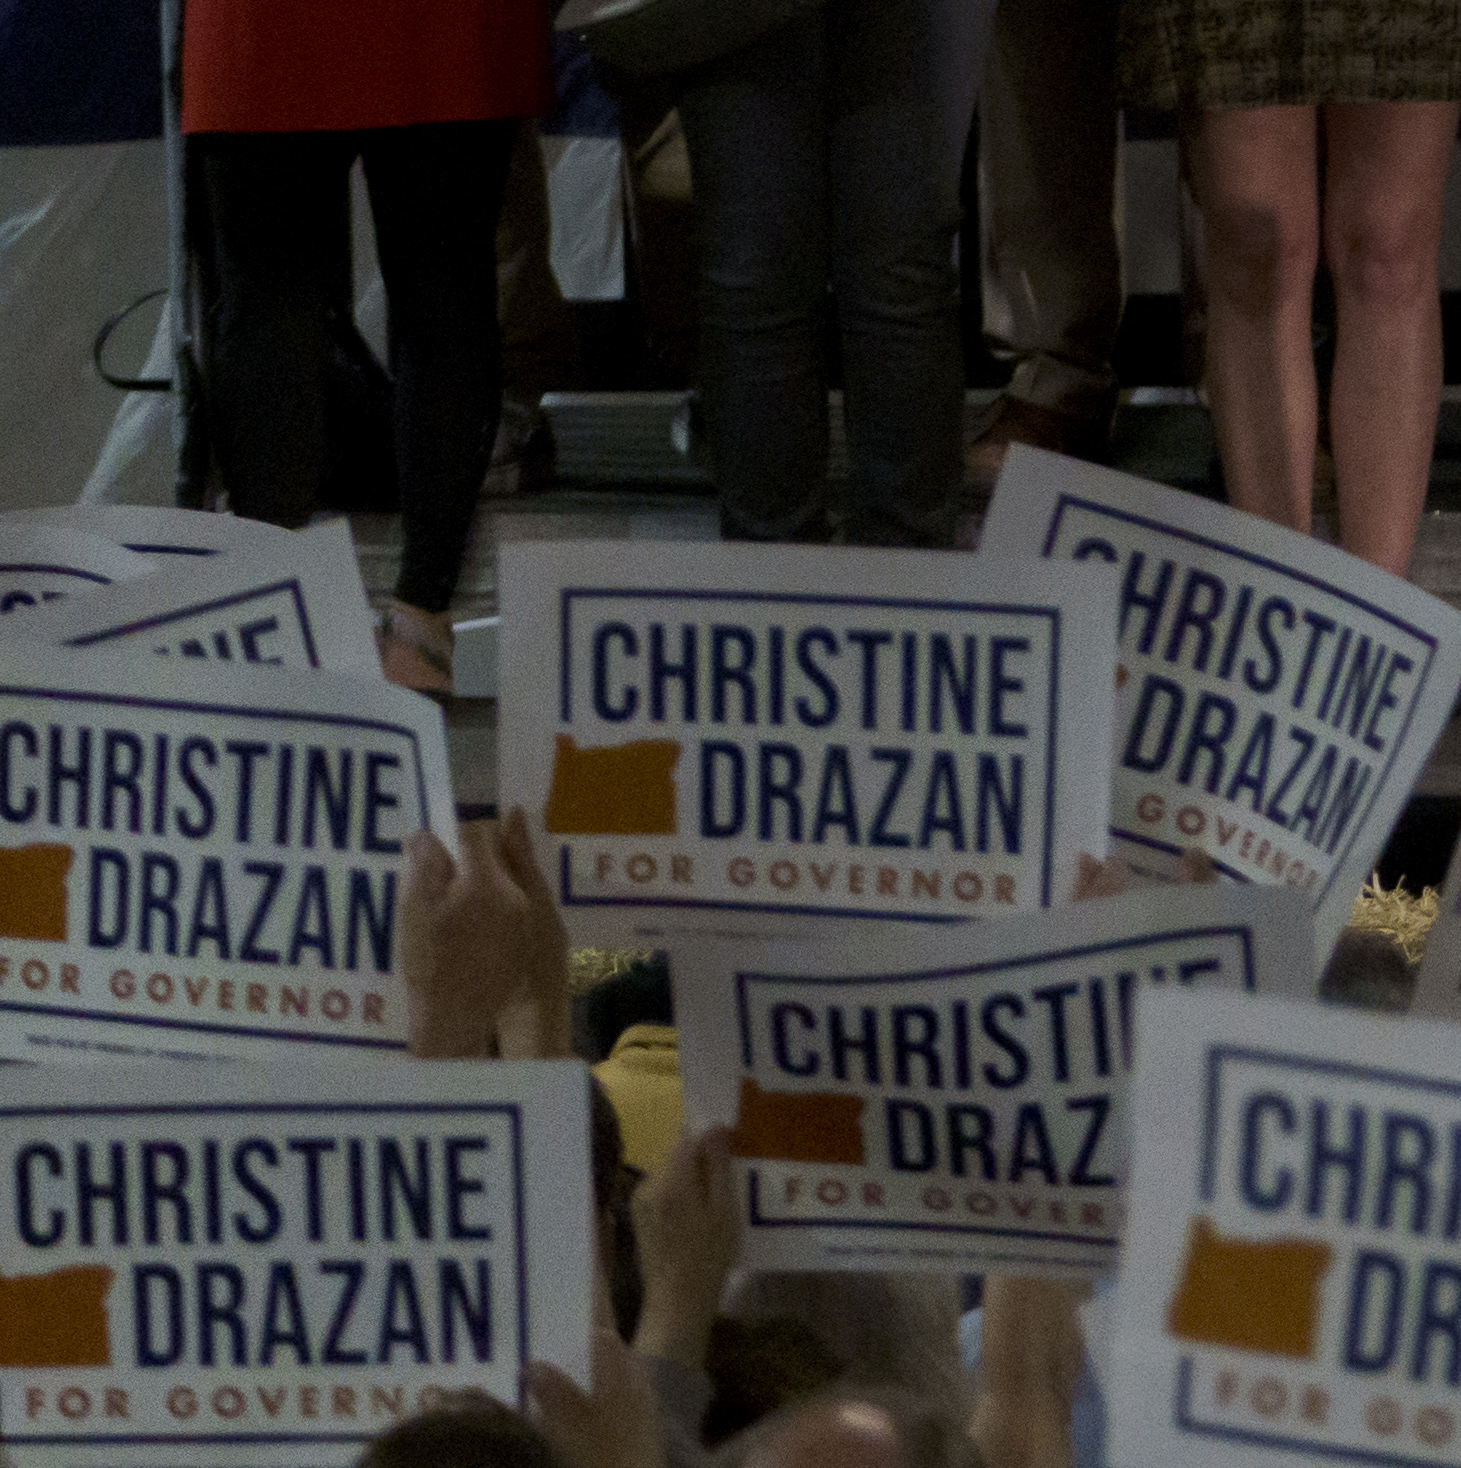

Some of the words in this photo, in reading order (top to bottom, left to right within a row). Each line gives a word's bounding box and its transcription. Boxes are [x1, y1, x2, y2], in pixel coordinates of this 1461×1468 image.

[593, 622, 1031, 739] CHRISTINE
[1073, 537, 1414, 752] HRISTINE
[0, 720, 402, 855] CHRISTINE
[700, 739, 1024, 855] DRAZAN
[1122, 675, 1373, 856] DRAZAN
[87, 845, 396, 973] DRAZAN
[597, 852, 694, 885] FOR
[726, 857, 1018, 905] GOVERNOR
[110, 969, 386, 1025] GOVERNOR
[15, 1135, 491, 1249] CHRISTINE
[785, 1178, 885, 1209] FOR
[885, 1093, 1118, 1188] DRAZ
[133, 1258, 493, 1369] DRAZAN
[24, 1386, 130, 1421] FOR
